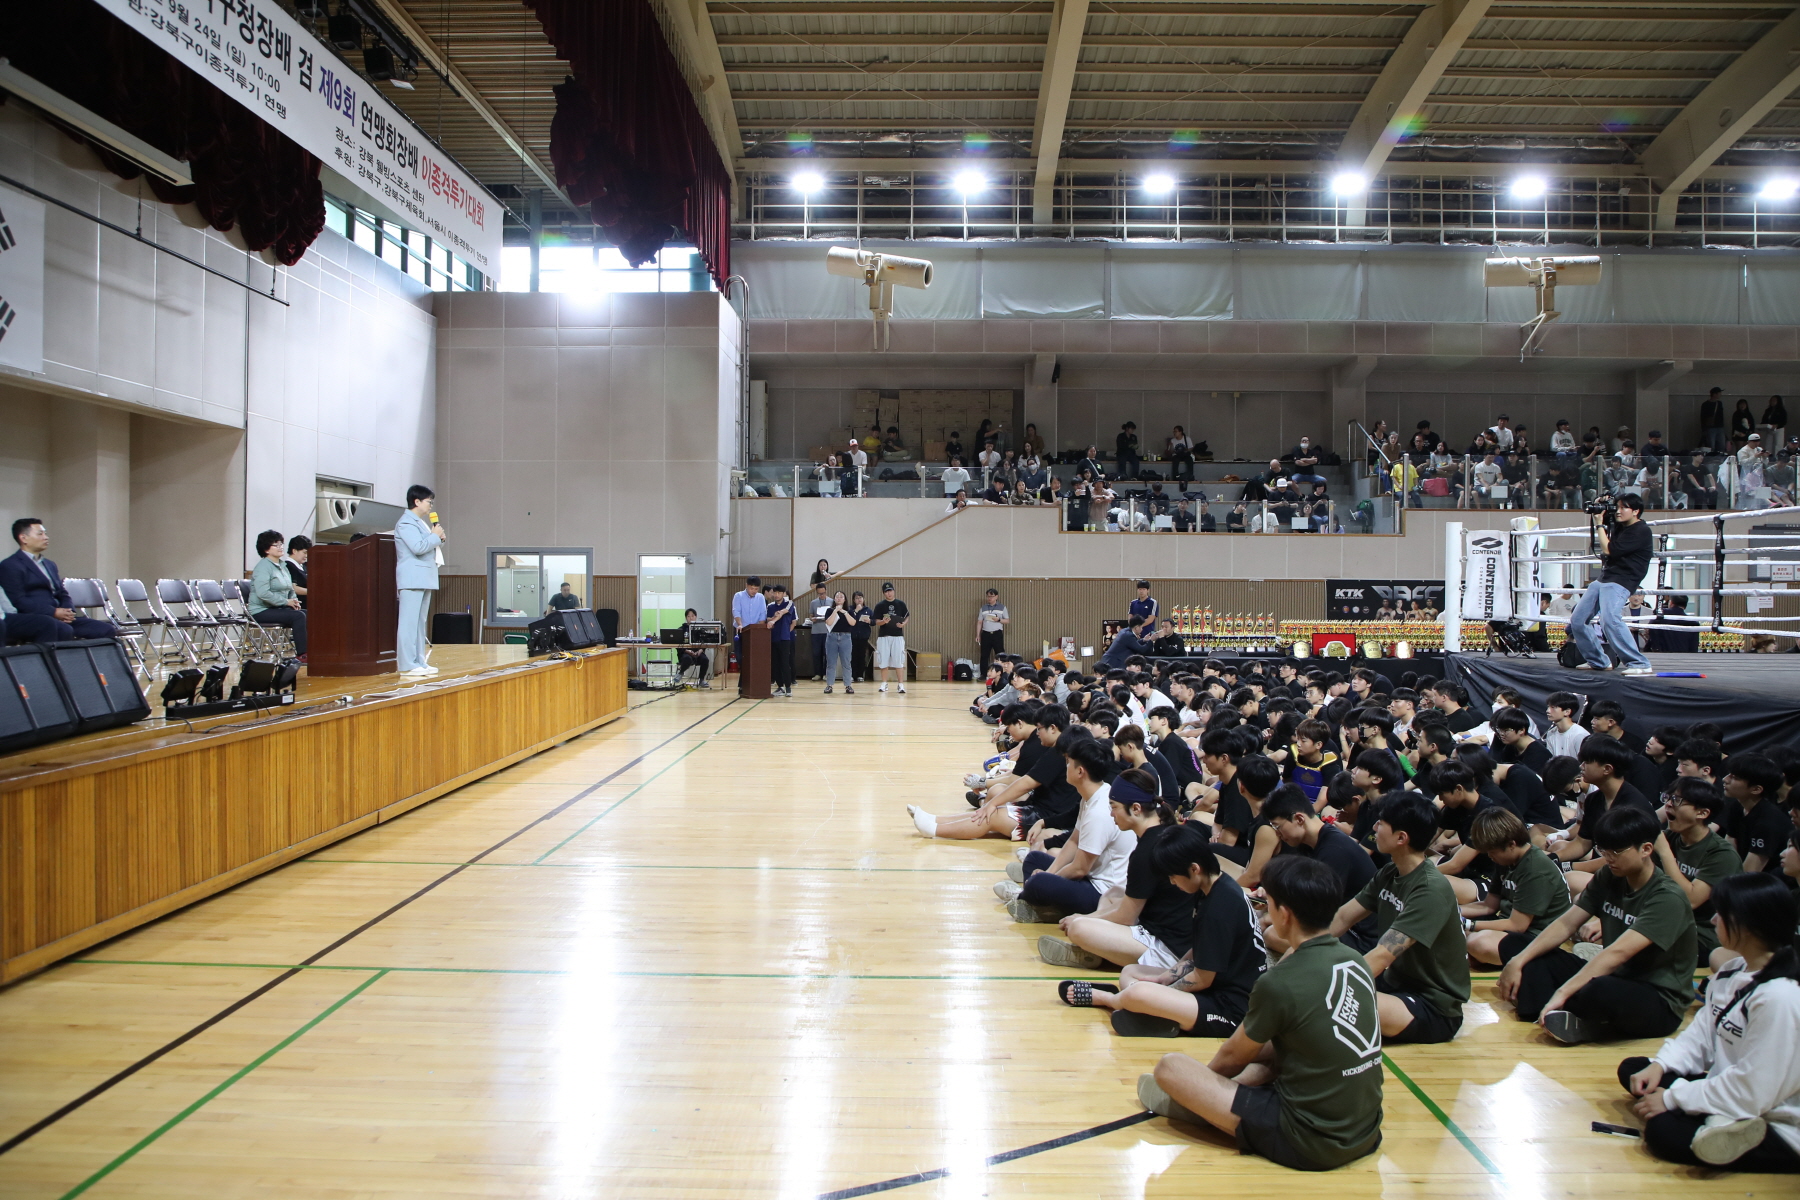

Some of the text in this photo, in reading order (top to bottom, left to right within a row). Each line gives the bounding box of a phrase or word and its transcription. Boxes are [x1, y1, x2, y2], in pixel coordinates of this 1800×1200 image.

[194, 18, 221, 50] 24일
[226, 41, 246, 68] (일)
[251, 62, 281, 93] 10:00
[208, 0, 485, 232] 구청장배 겸 제9회 연맹회장배 이종격투기대회
[264, 93, 287, 119] 연맹
[335, 126, 356, 149] 장소:
[359, 145, 374, 168] 강북
[1334, 588, 1365, 597] KTK
[1484, 557, 1496, 619] CONTENDER
[1751, 837, 1765, 848] 56
[1339, 985, 1355, 1020] KHAKI
[1348, 998, 1360, 1025] GYM
